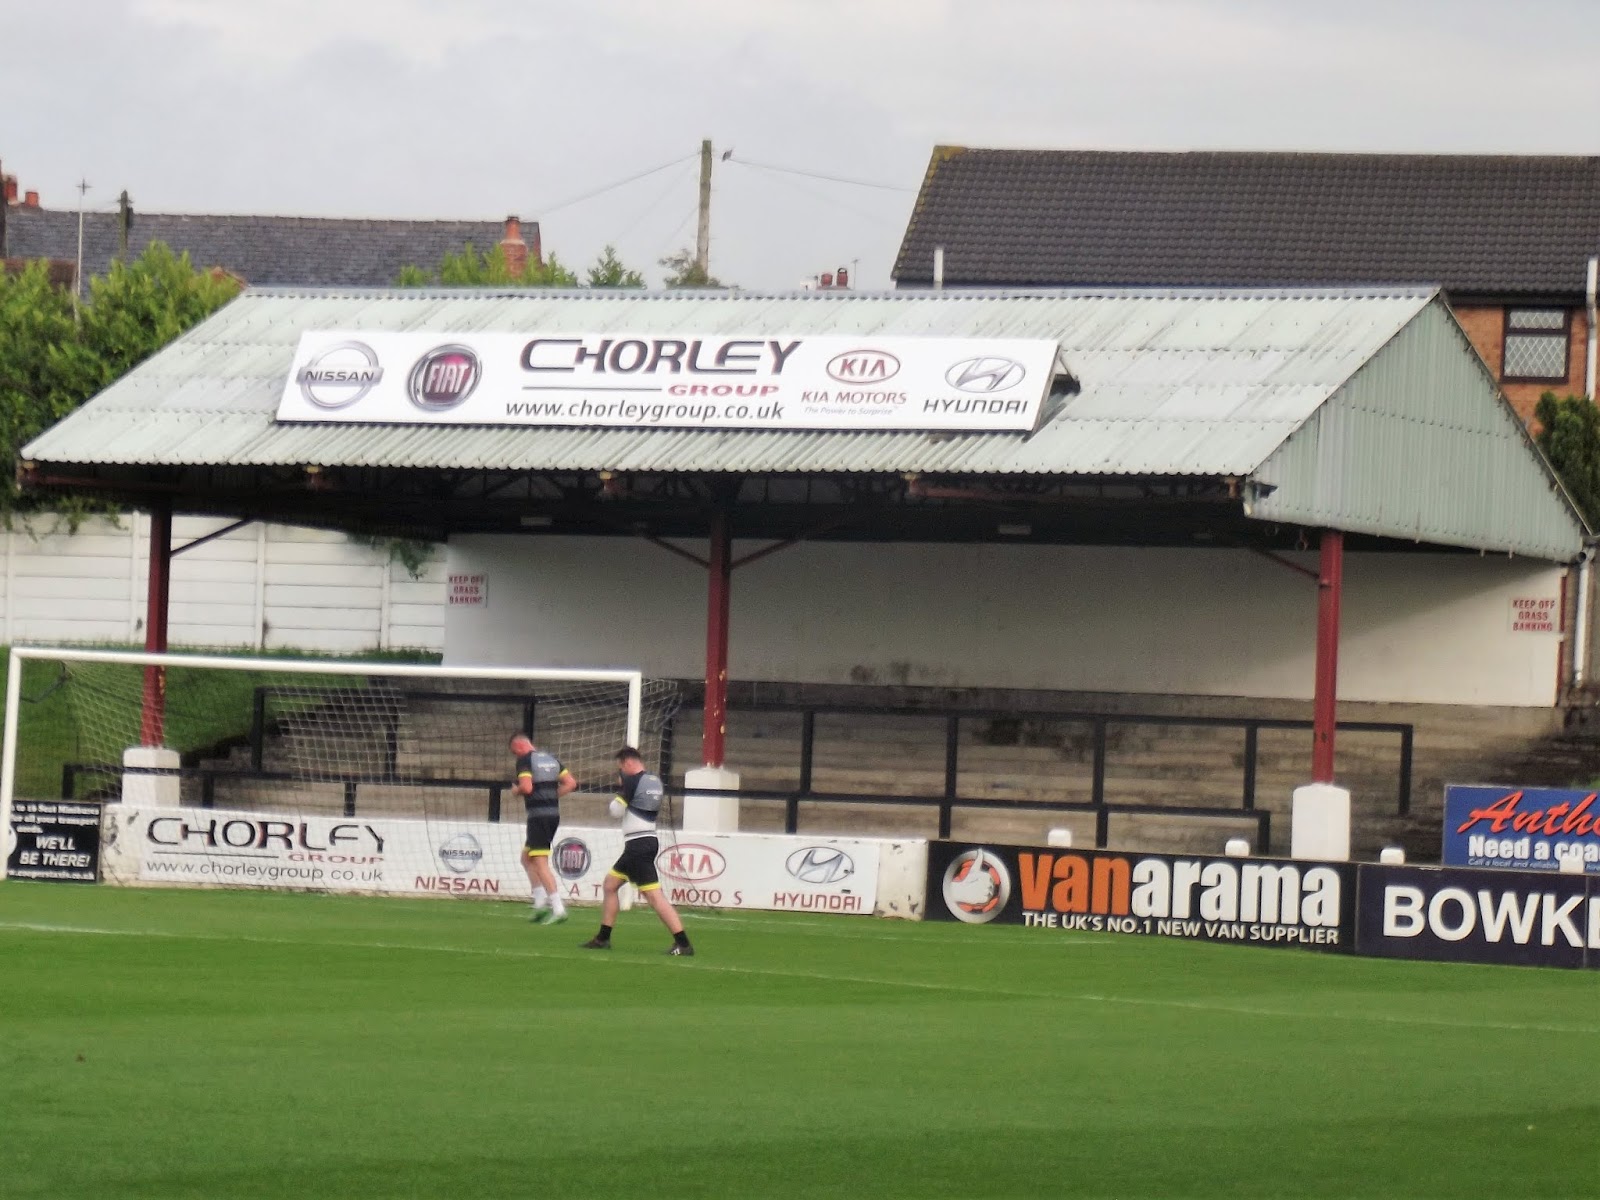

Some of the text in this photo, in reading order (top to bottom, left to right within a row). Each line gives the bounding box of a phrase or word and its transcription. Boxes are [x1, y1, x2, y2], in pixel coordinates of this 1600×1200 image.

[519, 338, 802, 375] CHORLEY
[304, 370, 375, 382] NISSAN
[839, 357, 888, 378] KIA
[425, 363, 469, 393] FIAT
[668, 384, 780, 397] GROUP
[801, 391, 907, 404] KIA MOTORS
[506, 400, 784, 423] www.chorleygroup.co.uk
[923, 398, 1029, 415] HYUNDAI
[1512, 600, 1555, 609] KEEP OFF
[1518, 611, 1548, 620] GRASS
[1512, 622, 1553, 631] BANKING
[36, 835, 76, 850] WE'LL
[1468, 834, 1531, 860] Need
[1534, 842, 1550, 860] a
[19, 850, 91, 868] BE THERE!
[288, 852, 384, 865] GROUP
[442, 849, 479, 858] NISSAN
[146, 861, 384, 881] www.chorleygroupco.uk
[669, 852, 714, 875] KIA
[415, 876, 499, 893] NISSAN
[1018, 852, 1341, 928] vanarama
[671, 888, 743, 906] MOTOS
[773, 892, 861, 911] HYUNDAI
[1022, 911, 1340, 945] THE UK'S NO.1 NEW VAN SUPPLIER
